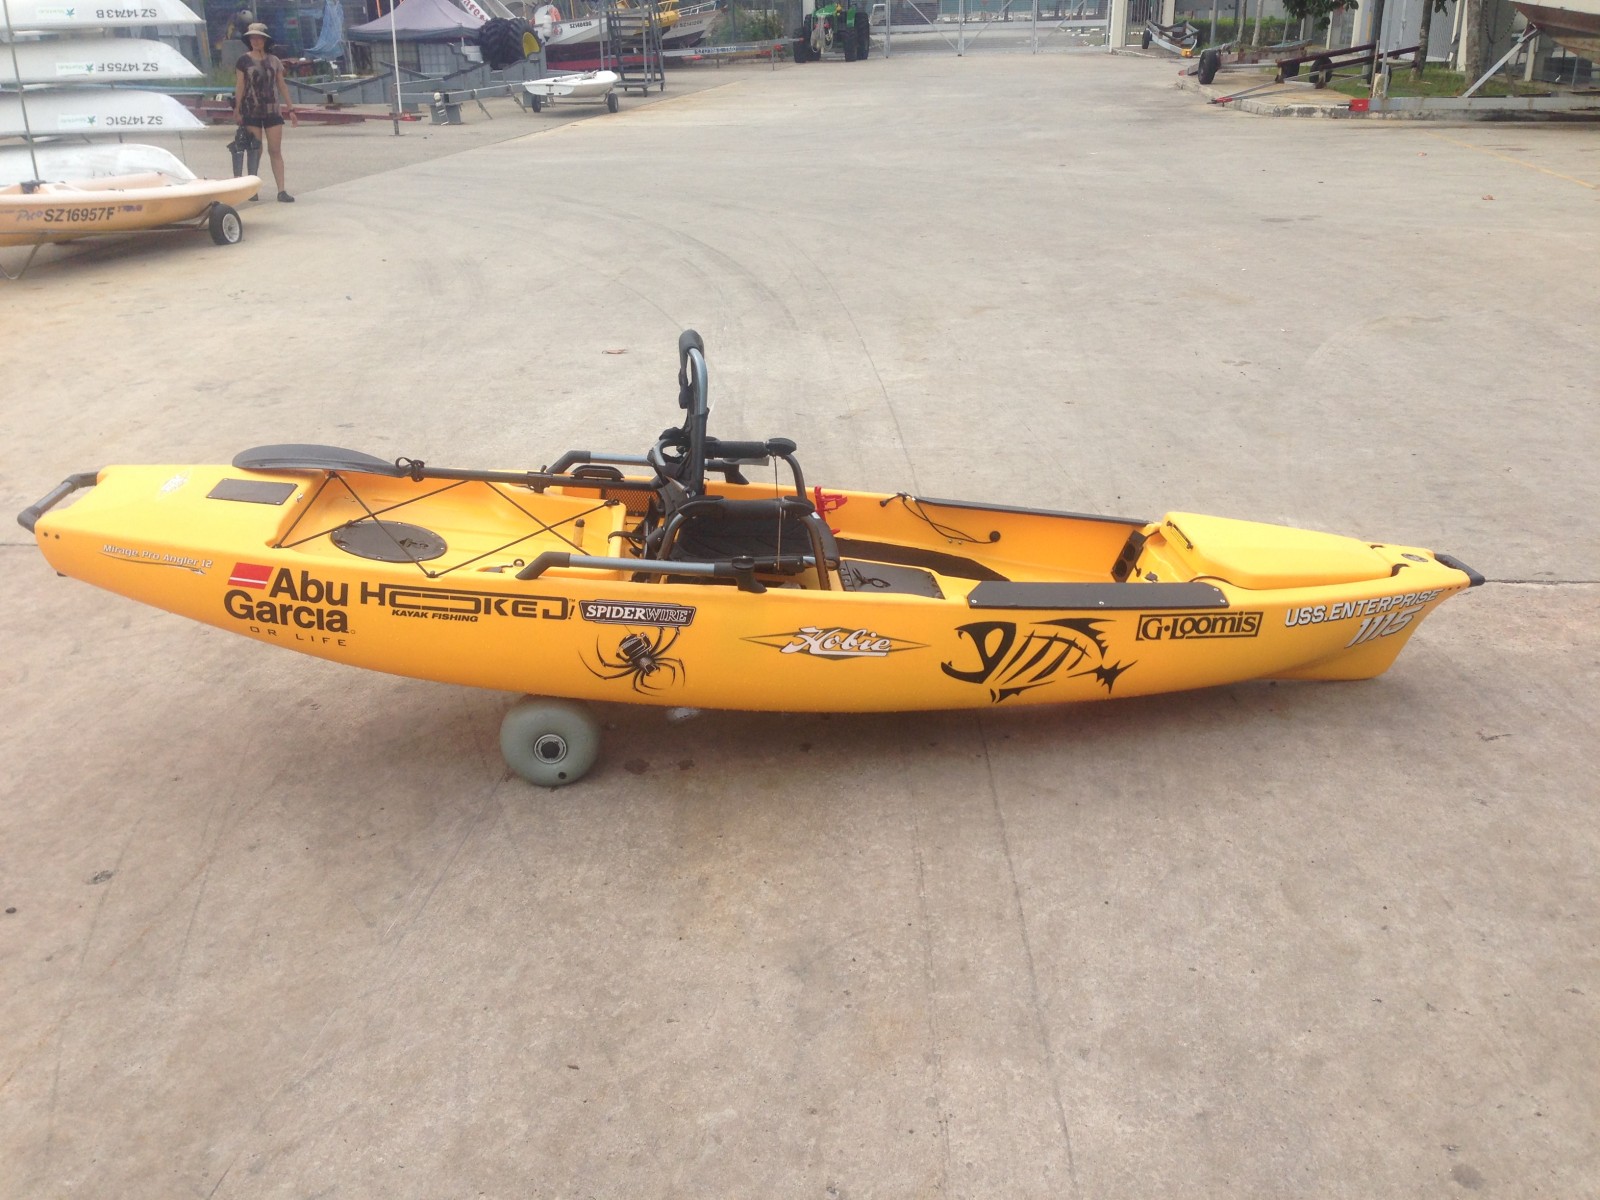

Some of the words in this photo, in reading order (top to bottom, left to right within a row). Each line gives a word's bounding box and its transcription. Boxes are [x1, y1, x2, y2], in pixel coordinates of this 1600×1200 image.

[106, 9, 138, 18] 14743
[141, 8, 157, 18] SZ
[97, 63, 105, 72] F
[106, 62, 139, 72] 14755
[143, 62, 159, 72] SZ
[146, 115, 163, 125] SZ
[44, 206, 115, 222] SZ16957F
[103, 544, 138, 557] Mirage
[142, 551, 160, 560] Pro
[163, 554, 199, 566] Angler
[201, 559, 213, 568] 12
[269, 567, 349, 607] Abu
[223, 589, 350, 634] Garcia
[391, 608, 429, 619] KAYAK
[431, 611, 479, 623] FISHING
[295, 633, 347, 647] LIFE
[779, 626, 893, 657] Hobie
